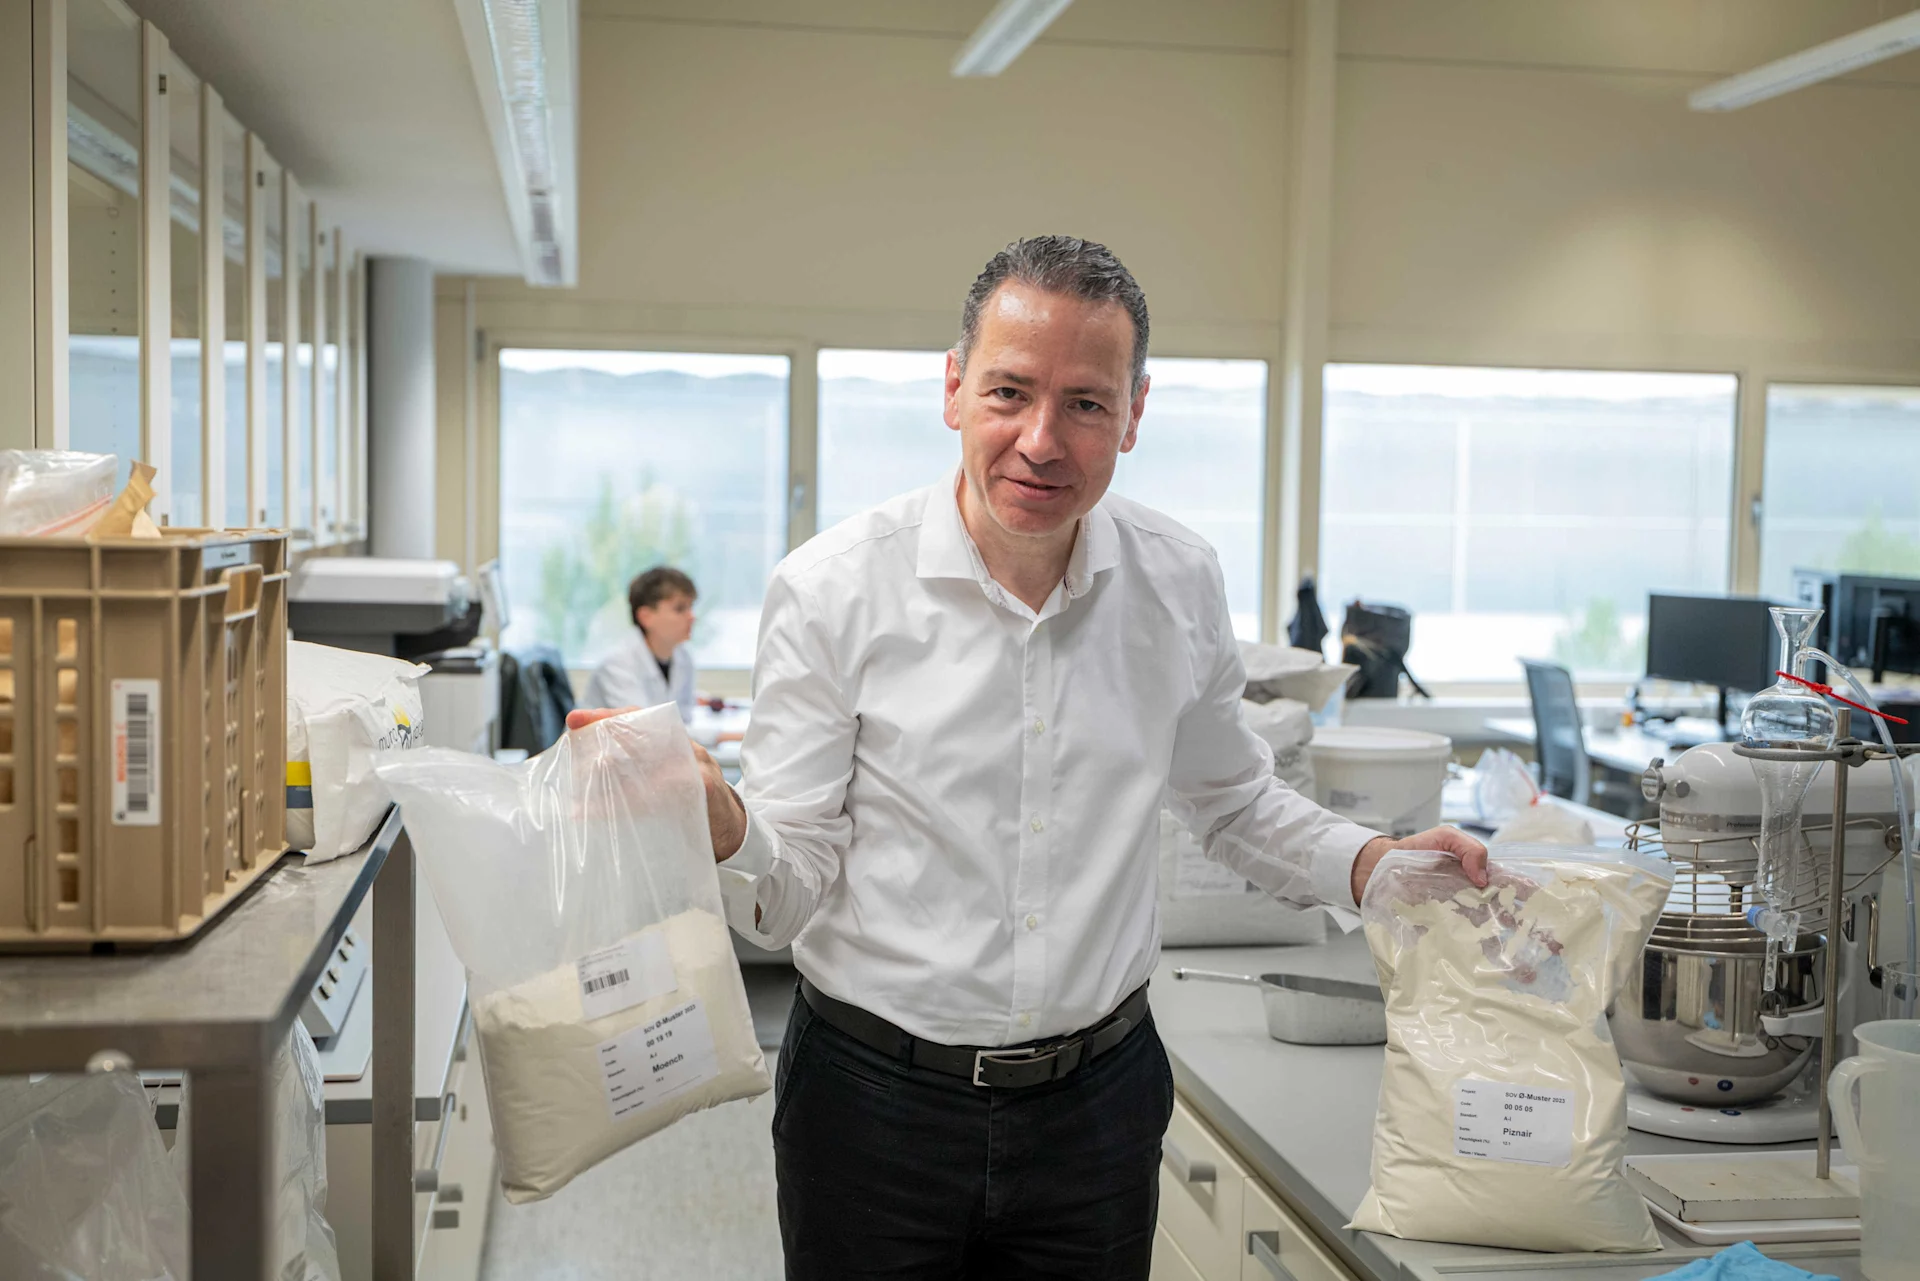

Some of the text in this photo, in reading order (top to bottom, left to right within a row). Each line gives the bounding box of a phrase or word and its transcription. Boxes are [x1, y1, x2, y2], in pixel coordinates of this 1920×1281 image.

[643, 1004, 697, 1035] SOV Ø-Muster 2023
[646, 1030, 673, 1048] 00 19 19
[652, 1053, 684, 1074] Moench
[1518, 1092, 1551, 1102] Ø-Muster
[1514, 1104, 1523, 1112] 05
[1524, 1105, 1533, 1113] 05
[1503, 1127, 1532, 1138] Piznair
